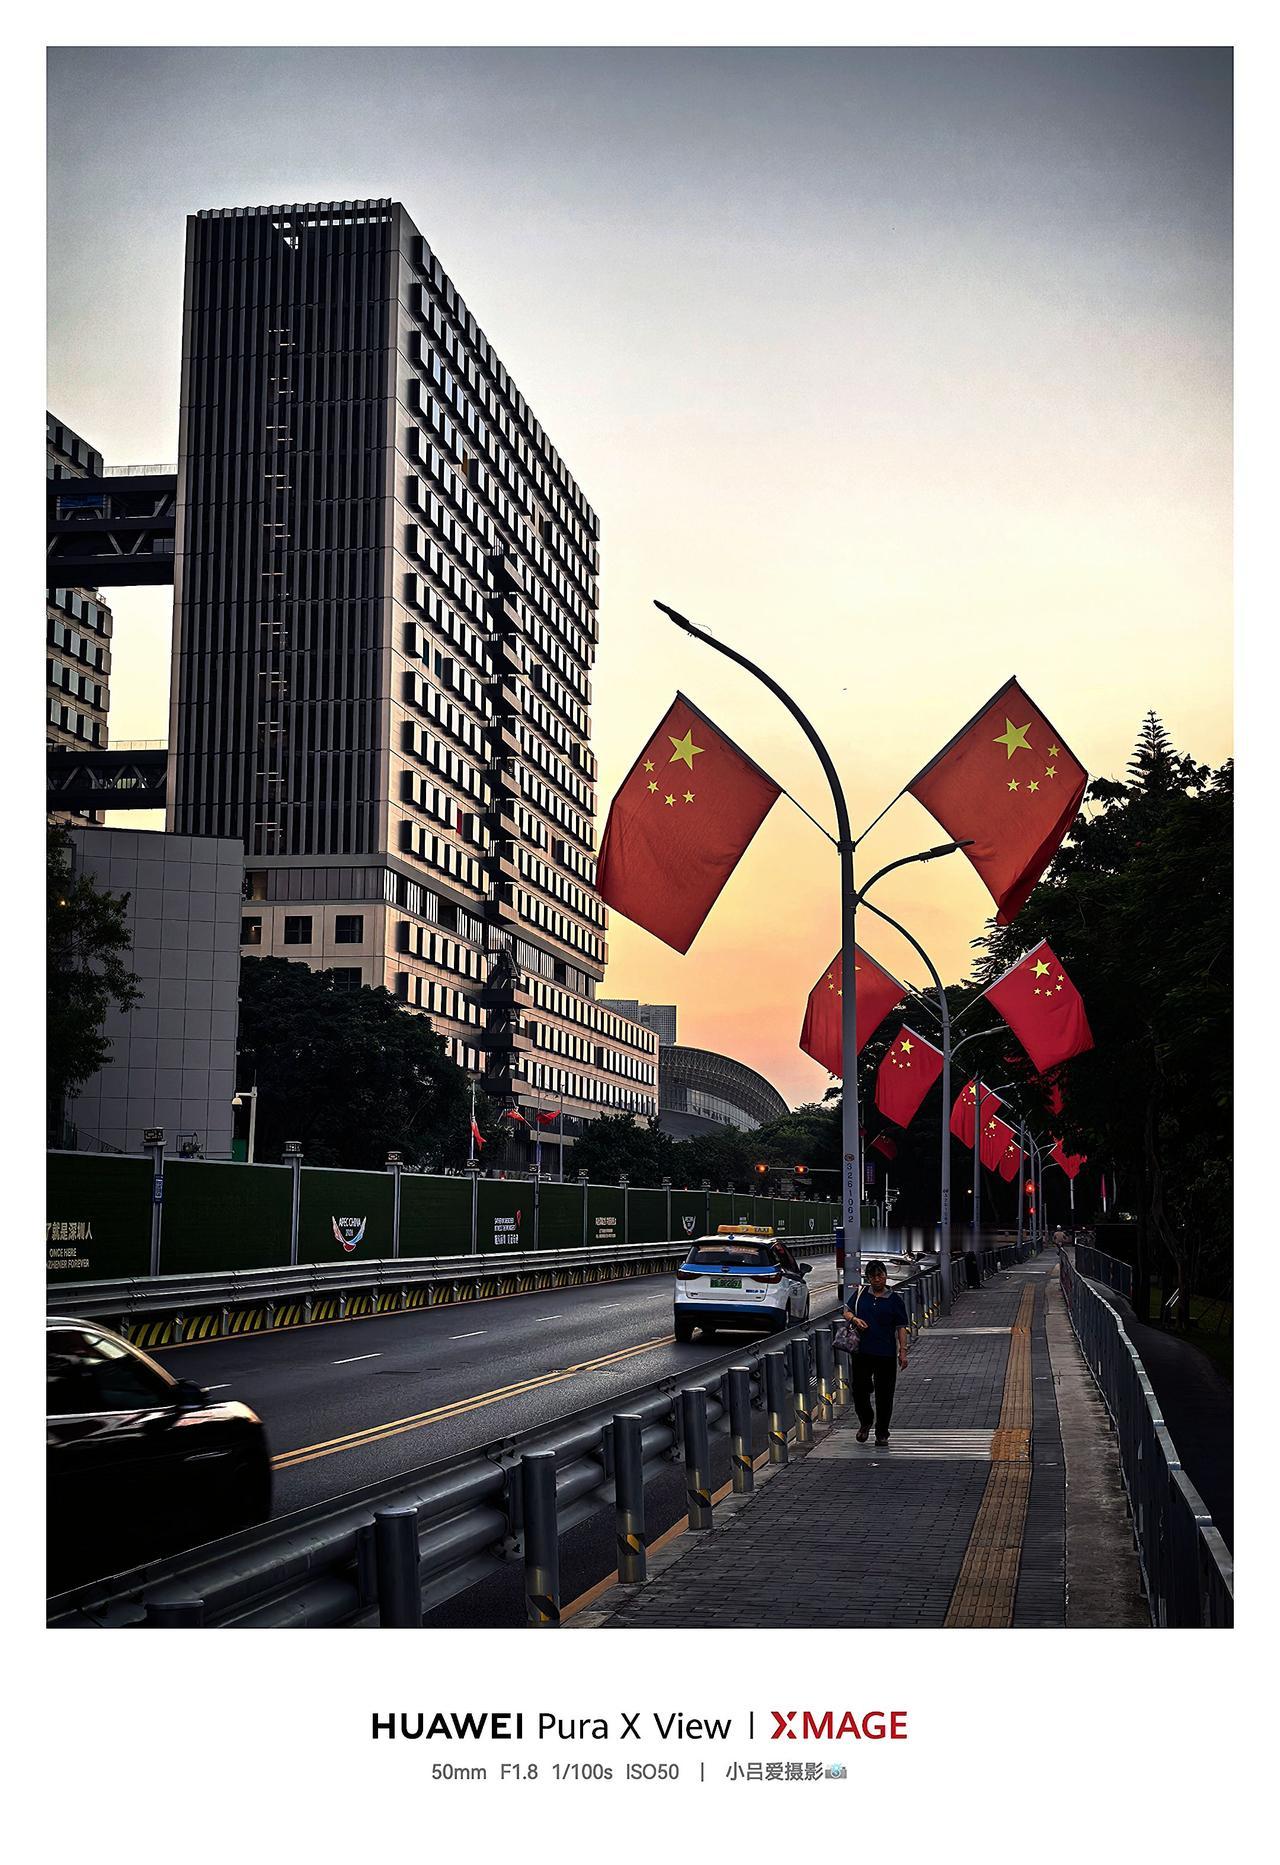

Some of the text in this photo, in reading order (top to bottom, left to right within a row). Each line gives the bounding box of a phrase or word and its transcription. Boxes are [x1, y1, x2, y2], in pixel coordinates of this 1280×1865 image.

[846, 1163, 854, 1223] 3261062
[49, 1247, 77, 1257] ONCE HERE
